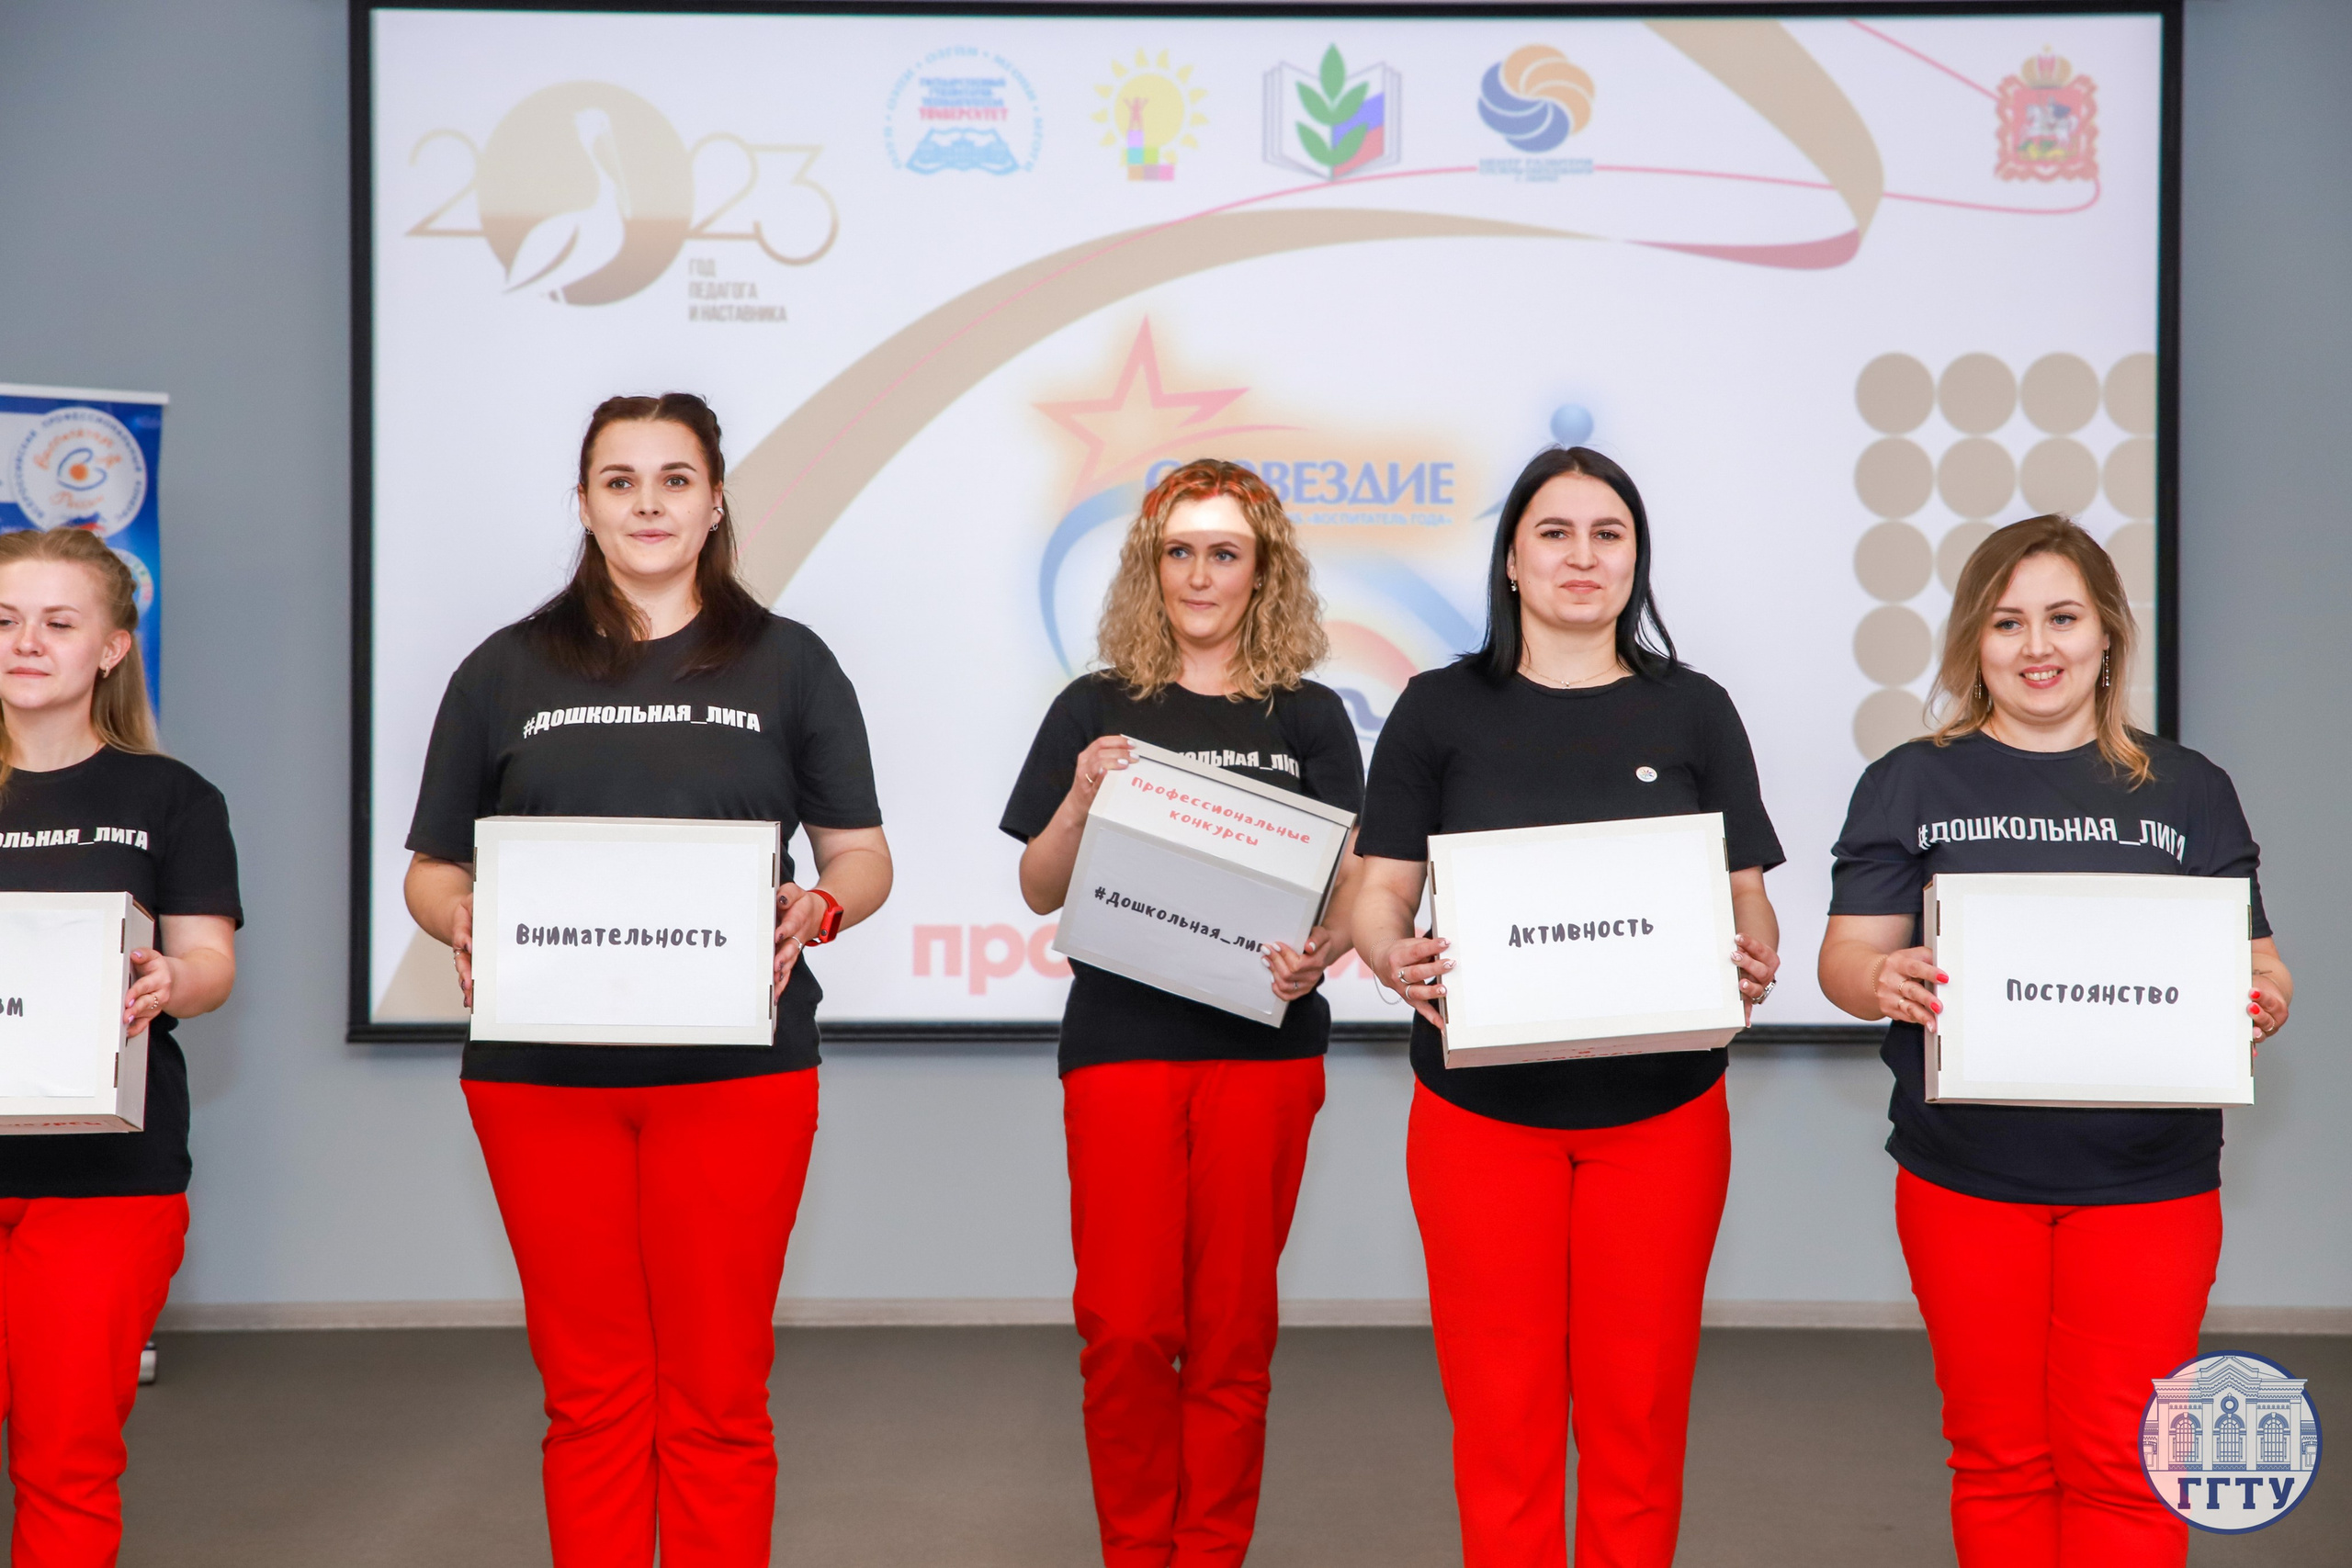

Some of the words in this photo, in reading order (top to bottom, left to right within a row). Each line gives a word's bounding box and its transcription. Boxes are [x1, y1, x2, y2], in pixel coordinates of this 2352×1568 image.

[688, 257, 717, 277] ГОД
[688, 280, 758, 300] ПЕДАГОГА
[701, 304, 787, 322] НАСТАВНИКА
[523, 705, 761, 739] #ДОШКОЛЬНАЯ_ЛИГА
[1131, 776, 1311, 844] Профессиональные
[1169, 809, 1259, 846] конкурсы
[1917, 816, 2187, 865] #ДОШКОЛЬНАЯ_ЛИГА
[1094, 886, 1263, 953] #Дошкольная_лиг
[1509, 918, 1654, 948] Активность
[515, 923, 728, 949] Внимательность
[2007, 978, 2179, 1006] Постоянство
